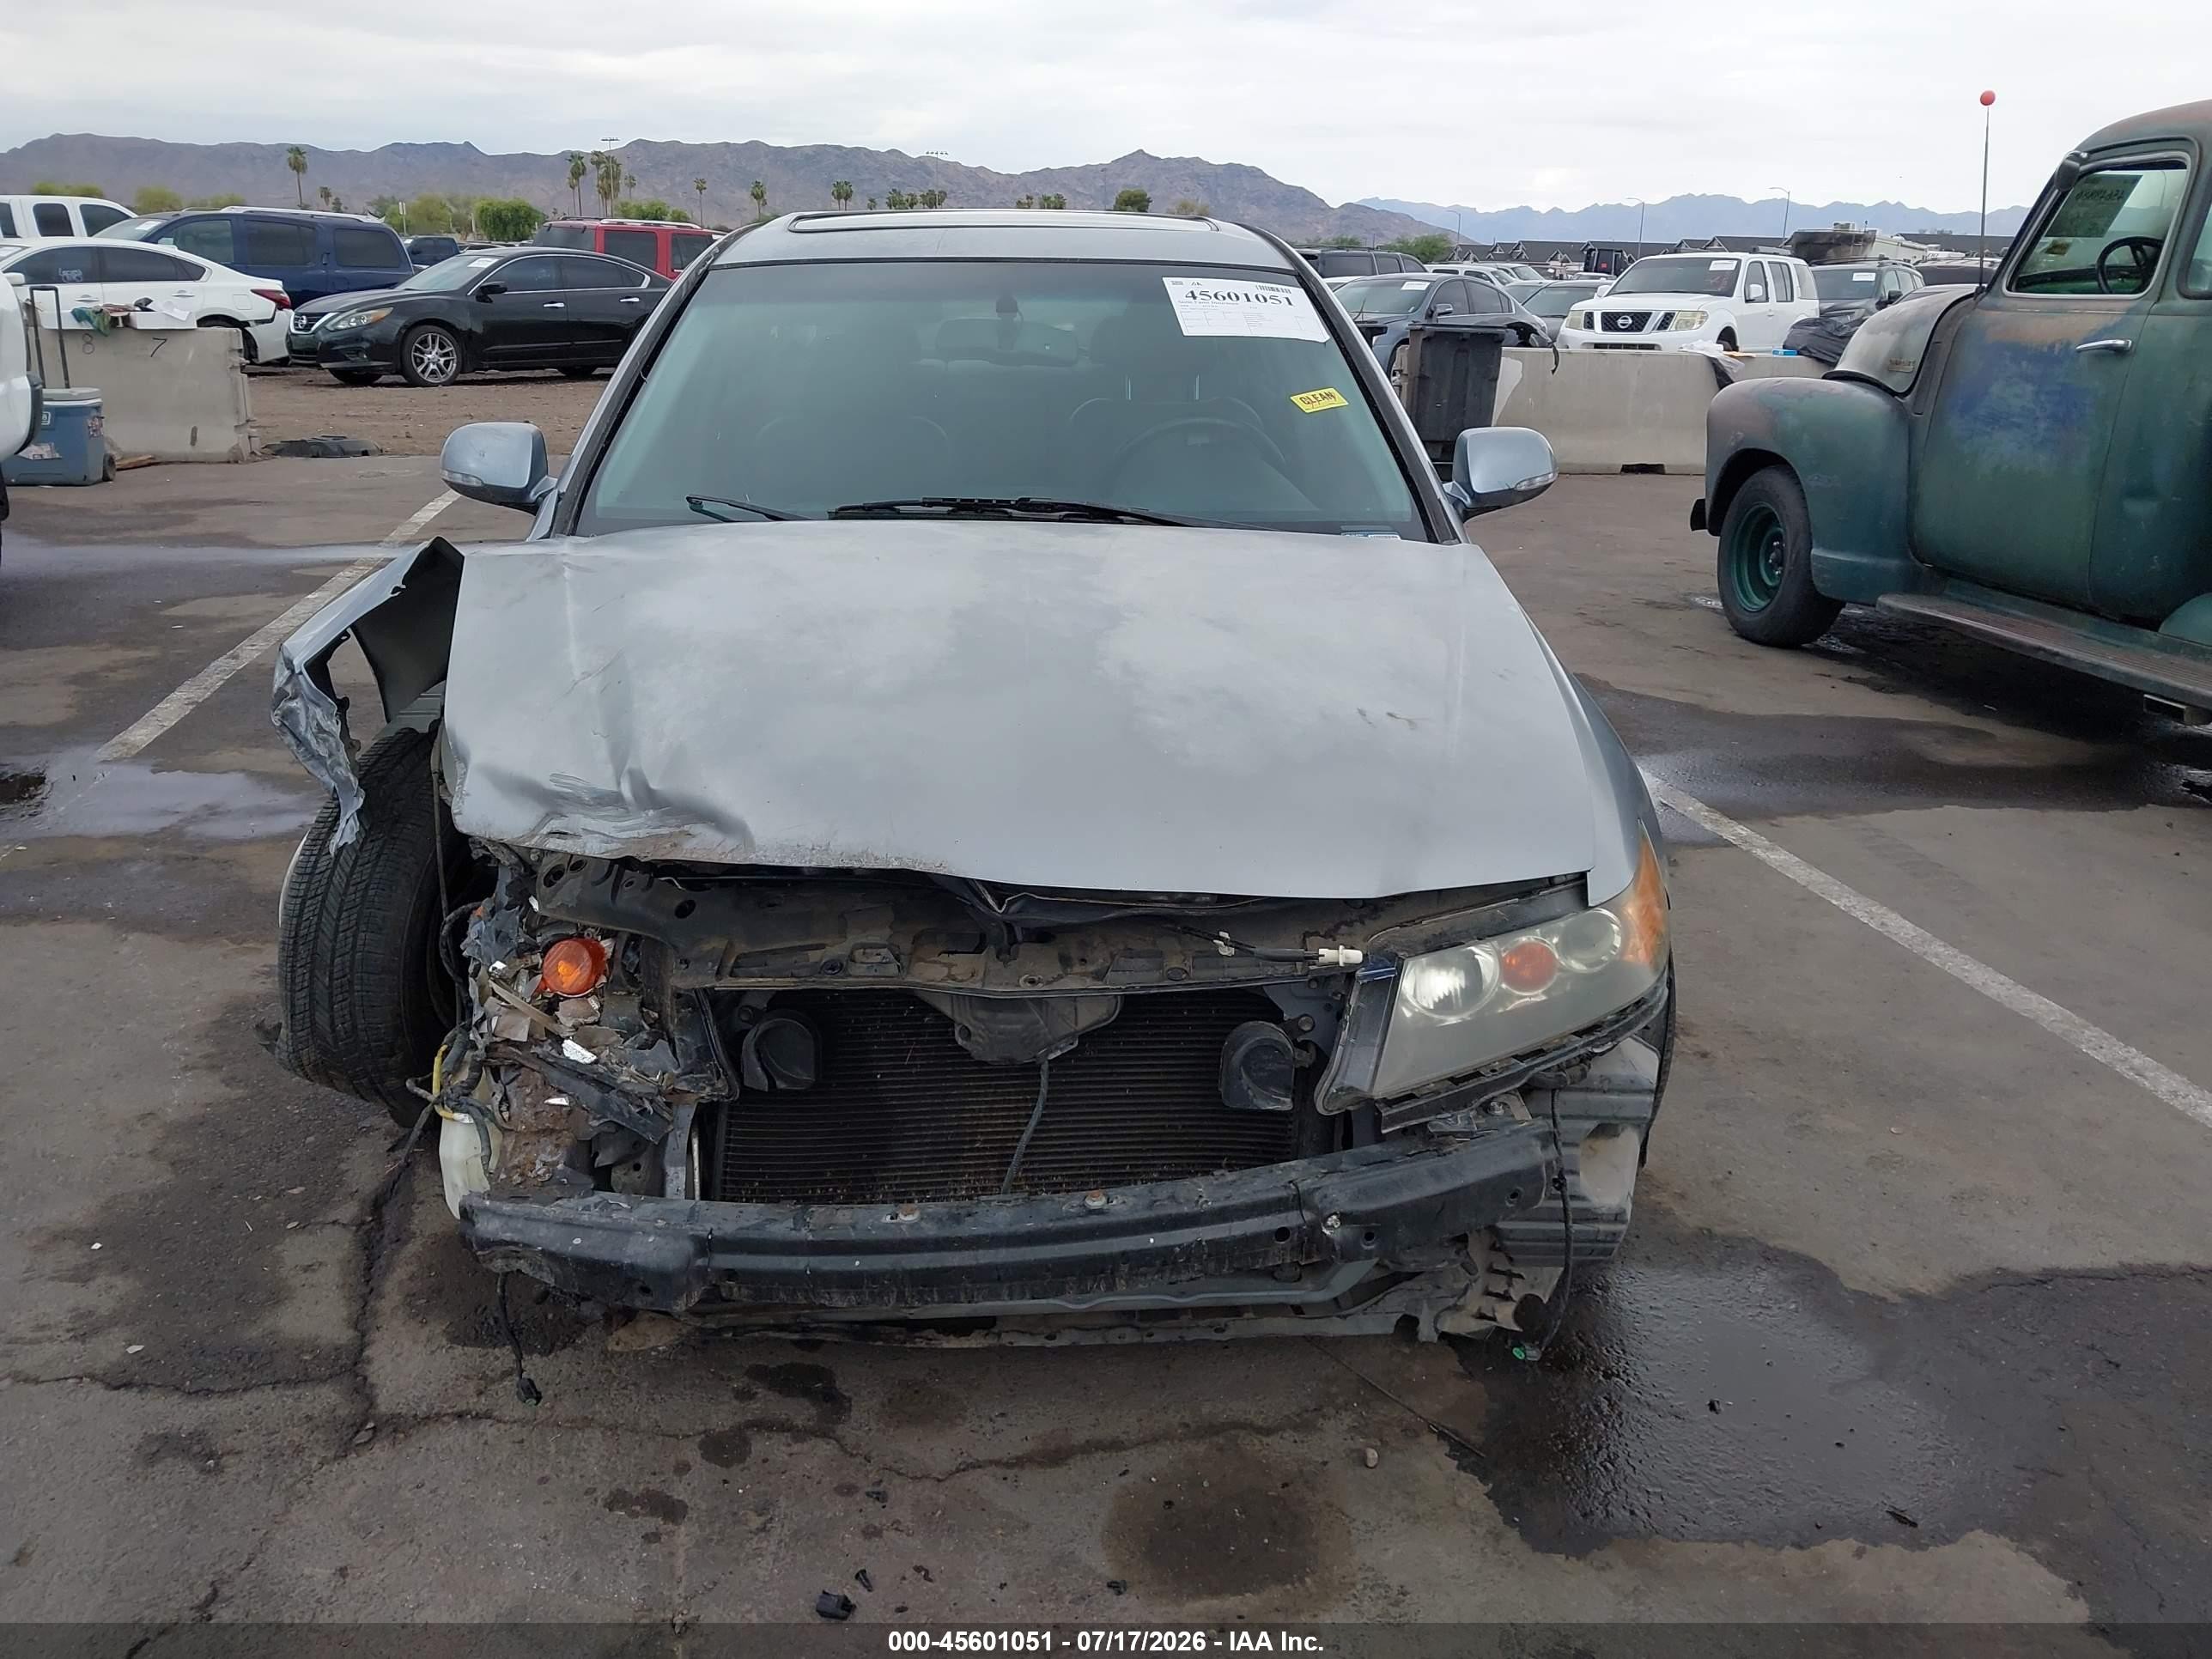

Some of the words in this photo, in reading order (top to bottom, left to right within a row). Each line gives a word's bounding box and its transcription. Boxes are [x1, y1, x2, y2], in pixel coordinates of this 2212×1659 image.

[1185, 289, 1294, 307] 45601051
[150, 337, 167, 357] 7
[1299, 392, 1335, 404] CLEAN
